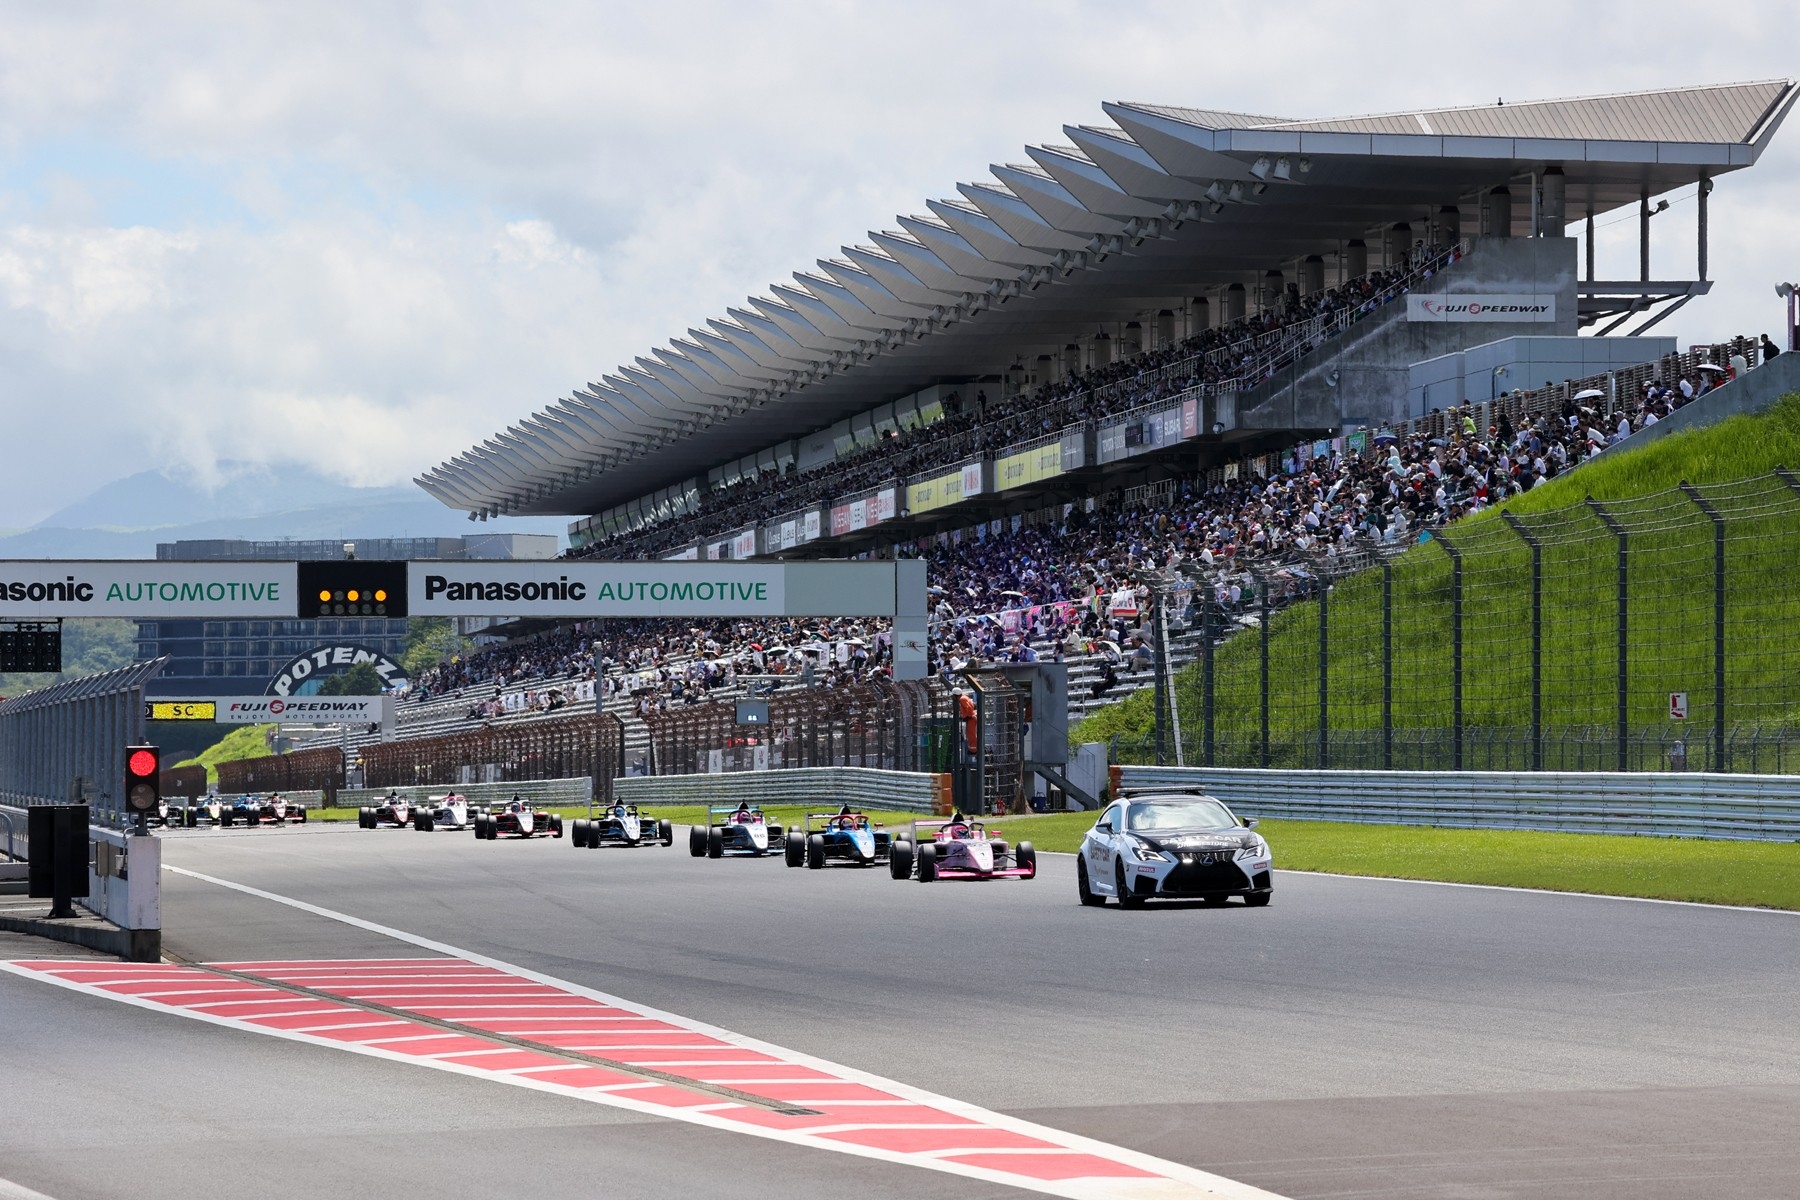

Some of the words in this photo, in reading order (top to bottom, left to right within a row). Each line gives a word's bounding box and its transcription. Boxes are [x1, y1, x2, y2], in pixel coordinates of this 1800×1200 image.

[106, 583, 279, 601] AUTOMOTIVE
[425, 576, 586, 601] Panasonic
[598, 582, 768, 600] AUTOMOTIVE
[173, 706, 194, 716] SC
[230, 703, 267, 711] FUJI
[269, 700, 368, 714] SPEEDWAY
